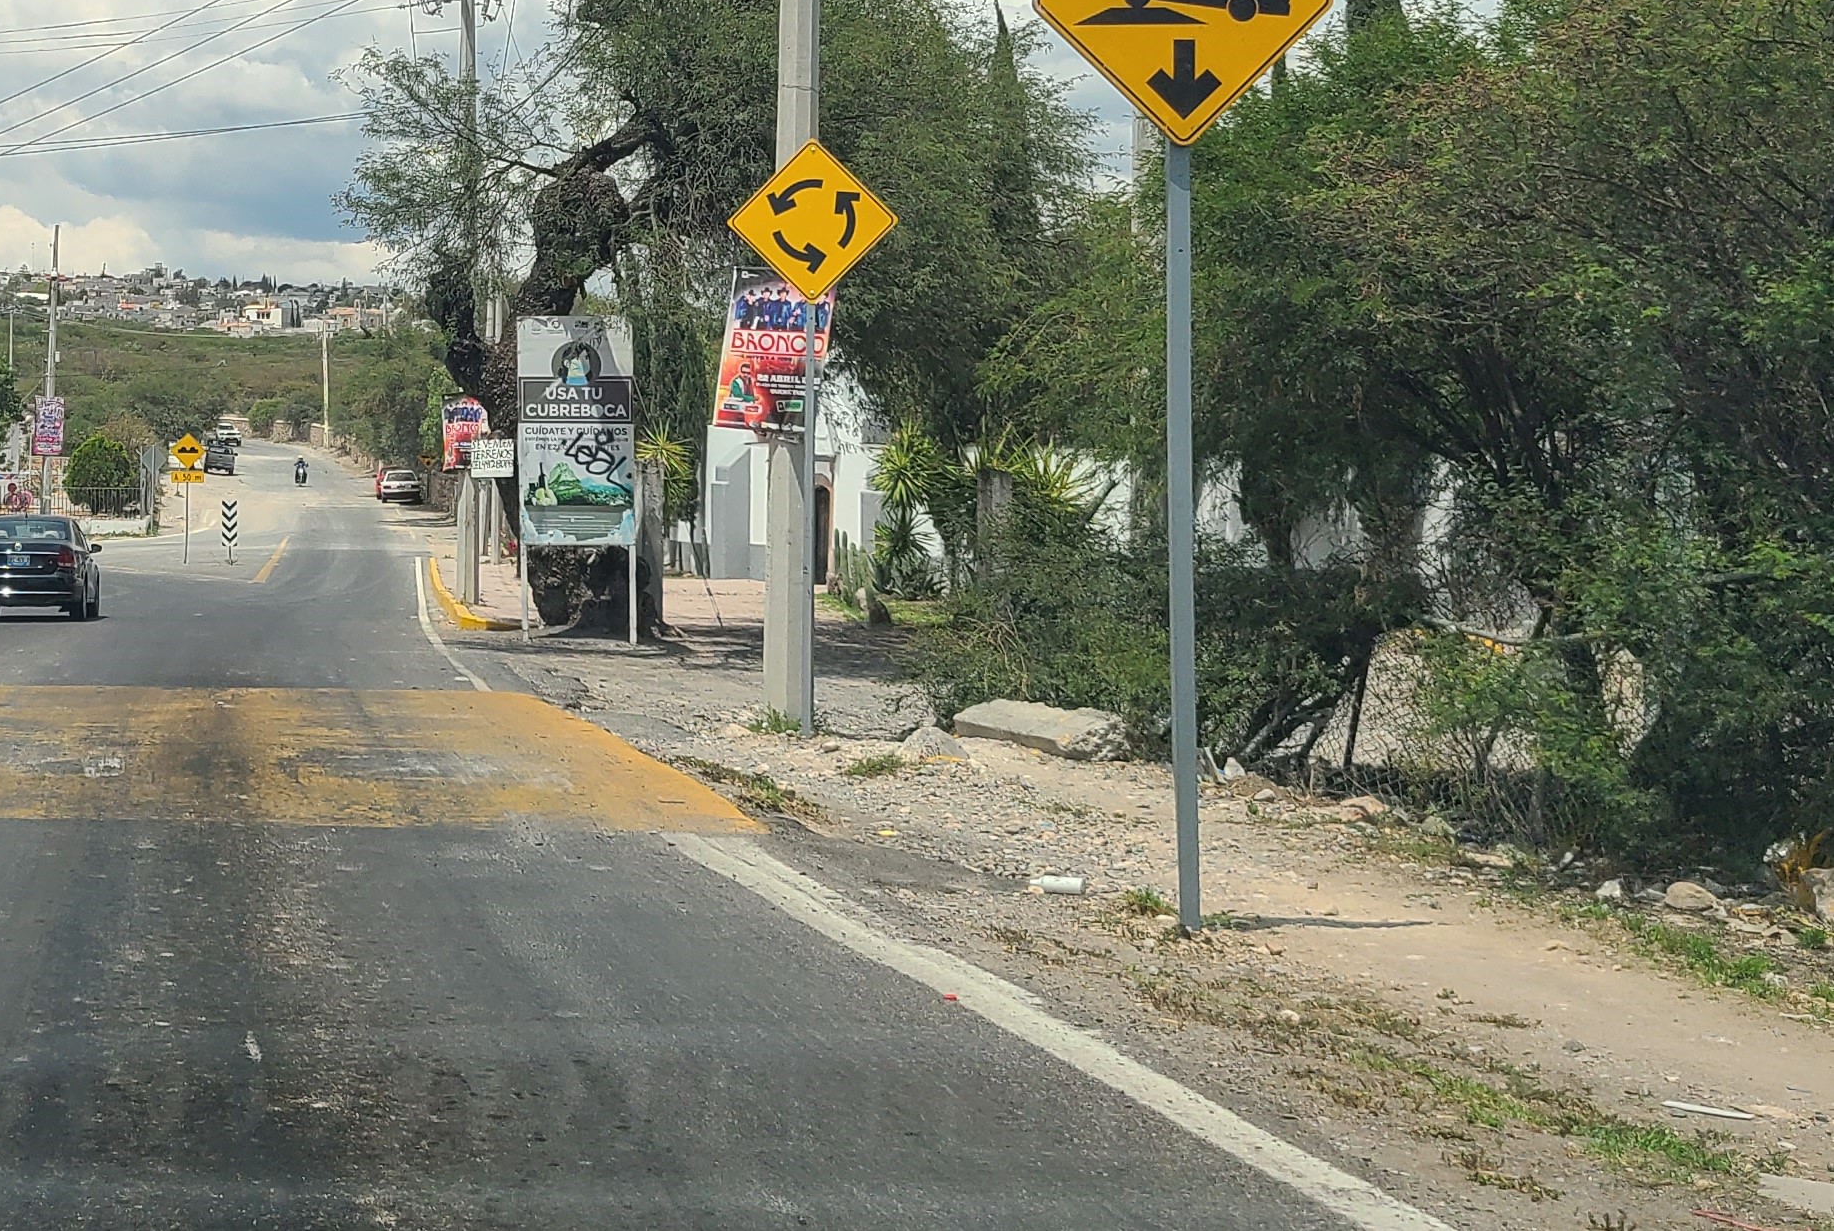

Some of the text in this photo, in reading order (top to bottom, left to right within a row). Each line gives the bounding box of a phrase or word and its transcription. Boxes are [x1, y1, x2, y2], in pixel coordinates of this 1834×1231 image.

[731, 331, 825, 354] BRONCO
[545, 386, 603, 400] USA TU
[525, 403, 628, 418] CUBREBOCA
[525, 425, 566, 435] CUÍDATE
[567, 426, 574, 435] Y
[173, 473, 179, 481] A
[182, 473, 192, 481] 50
